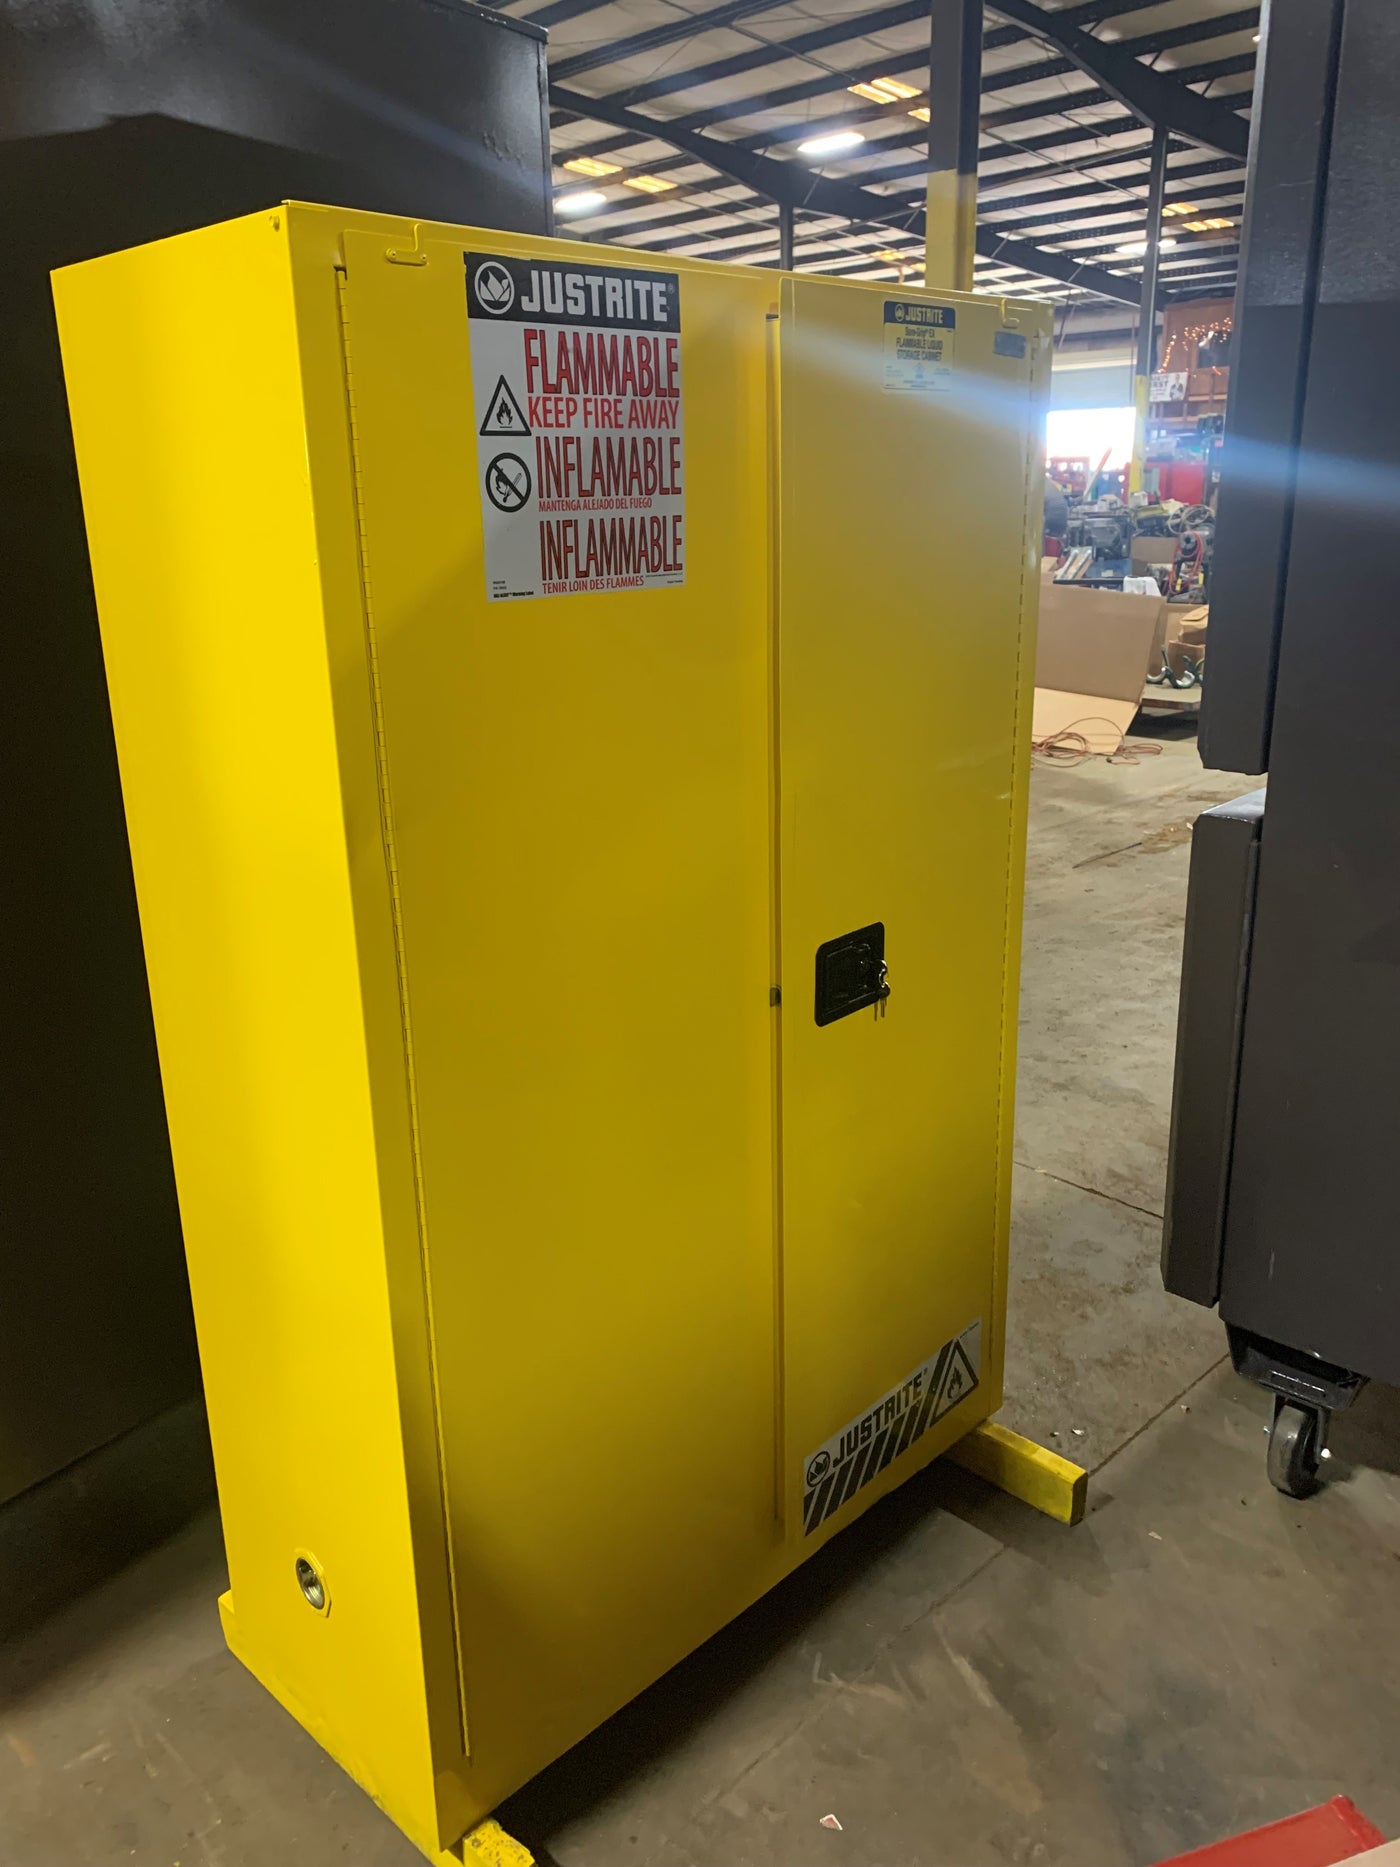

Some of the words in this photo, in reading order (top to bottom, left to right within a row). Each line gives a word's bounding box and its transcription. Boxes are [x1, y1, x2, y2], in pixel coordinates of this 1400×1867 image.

[905, 306, 943, 324] JUSTRITE
[524, 328, 680, 398] FLAMMABLE
[528, 396, 578, 429] KEEP
[583, 397, 624, 429] FIRE
[628, 399, 679, 429] AWAY
[536, 436, 682, 499] INFLAMABLE
[538, 500, 581, 512] MANTENGA
[582, 499, 614, 511] ALEJADO
[615, 499, 629, 510] DEL
[629, 498, 652, 509] FUEGO
[539, 515, 683, 581] INFLAMMABLE
[542, 581, 568, 595] TENIR
[569, 579, 588, 592] LOIN
[589, 578, 605, 591] DES
[606, 575, 644, 589] FLAMMES
[833, 1372, 923, 1468] JUSTRITE
